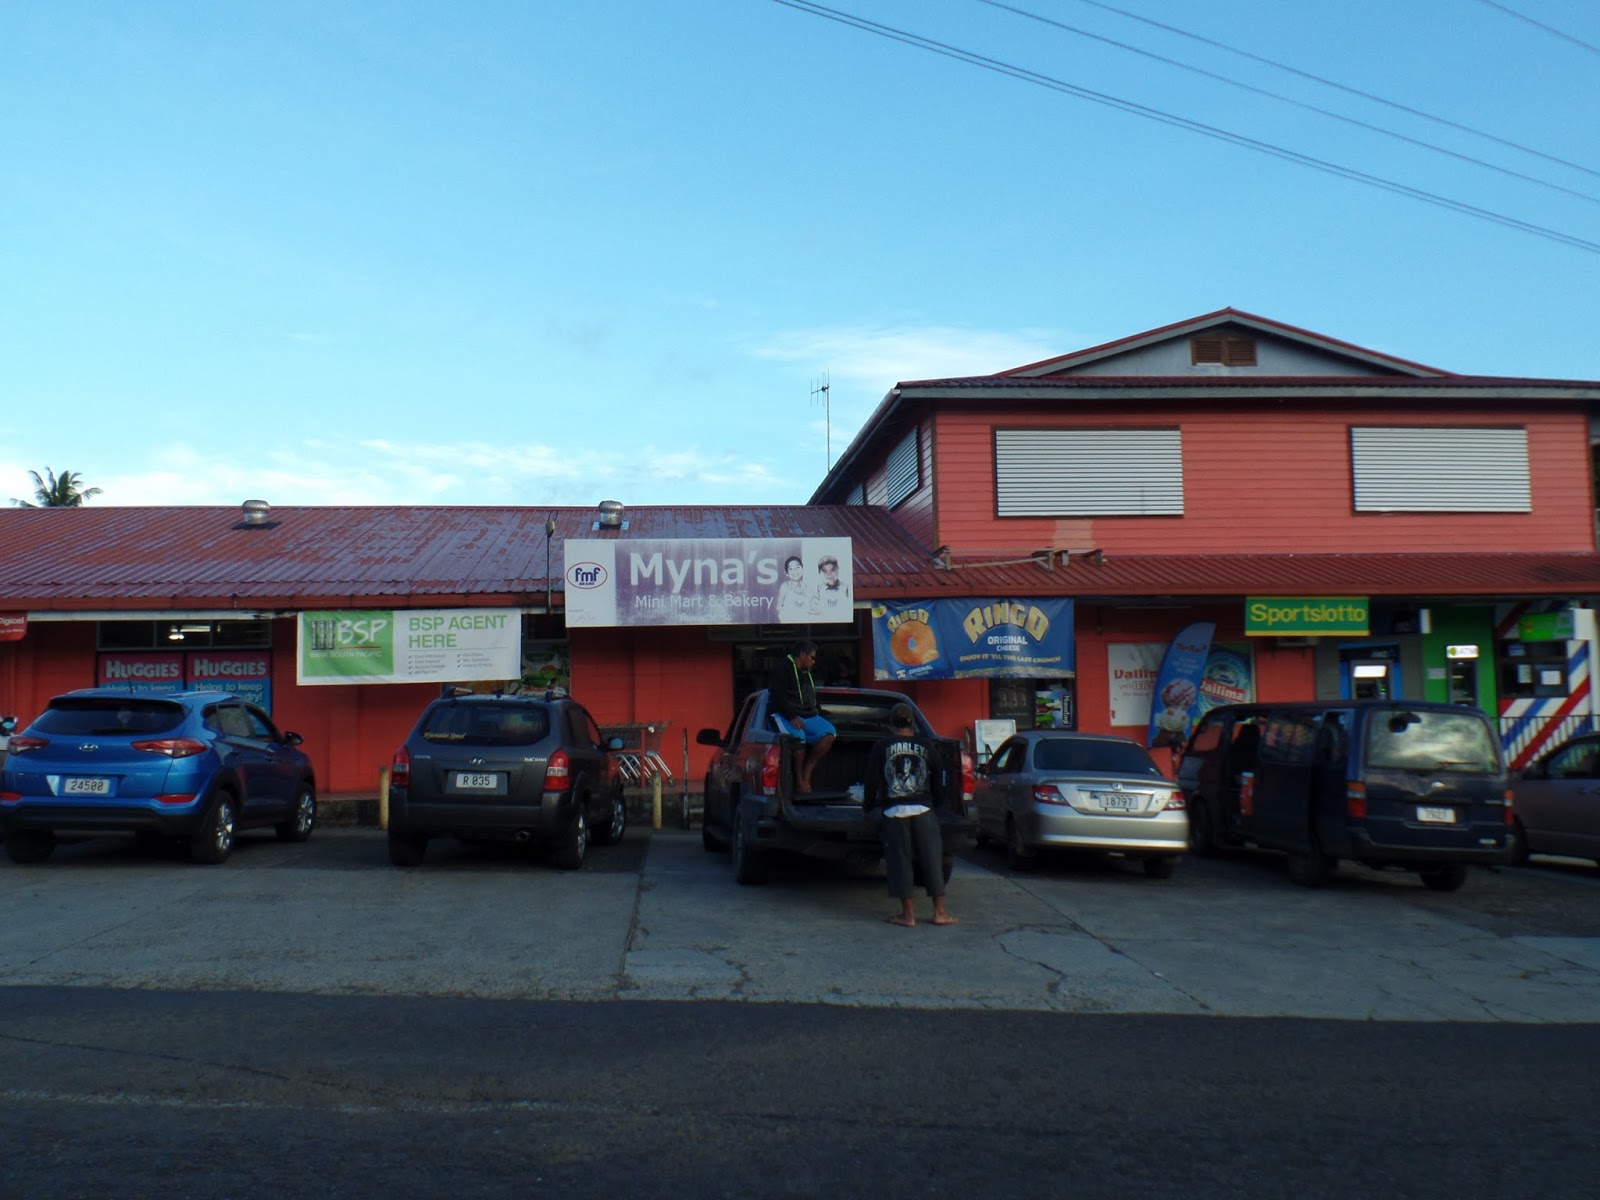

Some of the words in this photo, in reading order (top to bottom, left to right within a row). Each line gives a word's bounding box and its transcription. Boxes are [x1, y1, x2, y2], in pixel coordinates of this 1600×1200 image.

[575, 567, 601, 582] fmf
[630, 552, 778, 593] Myna's
[635, 595, 664, 609] Mini
[670, 595, 703, 608] Mart
[708, 595, 722, 608] &
[727, 594, 774, 611] Bakery
[409, 617, 444, 631] BSP
[448, 614, 508, 630] AGENT
[886, 608, 929, 634] RINGO
[1250, 603, 1366, 626] Sportslotto
[338, 619, 388, 644] BSP
[963, 603, 1049, 644] RINGO
[408, 633, 458, 648] HERE
[987, 635, 1028, 645] ORIGINAL
[193, 658, 266, 676] HUGGIES
[1032, 656, 1062, 664] CRUNCH
[105, 660, 179, 678] HUGGIES
[1114, 669, 1158, 679] Vailim
[225, 683, 236, 691] to
[238, 682, 263, 695] keep
[890, 742, 925, 755] MARLEY
[463, 777, 469, 786] R
[1105, 797, 1133, 807] 18797
